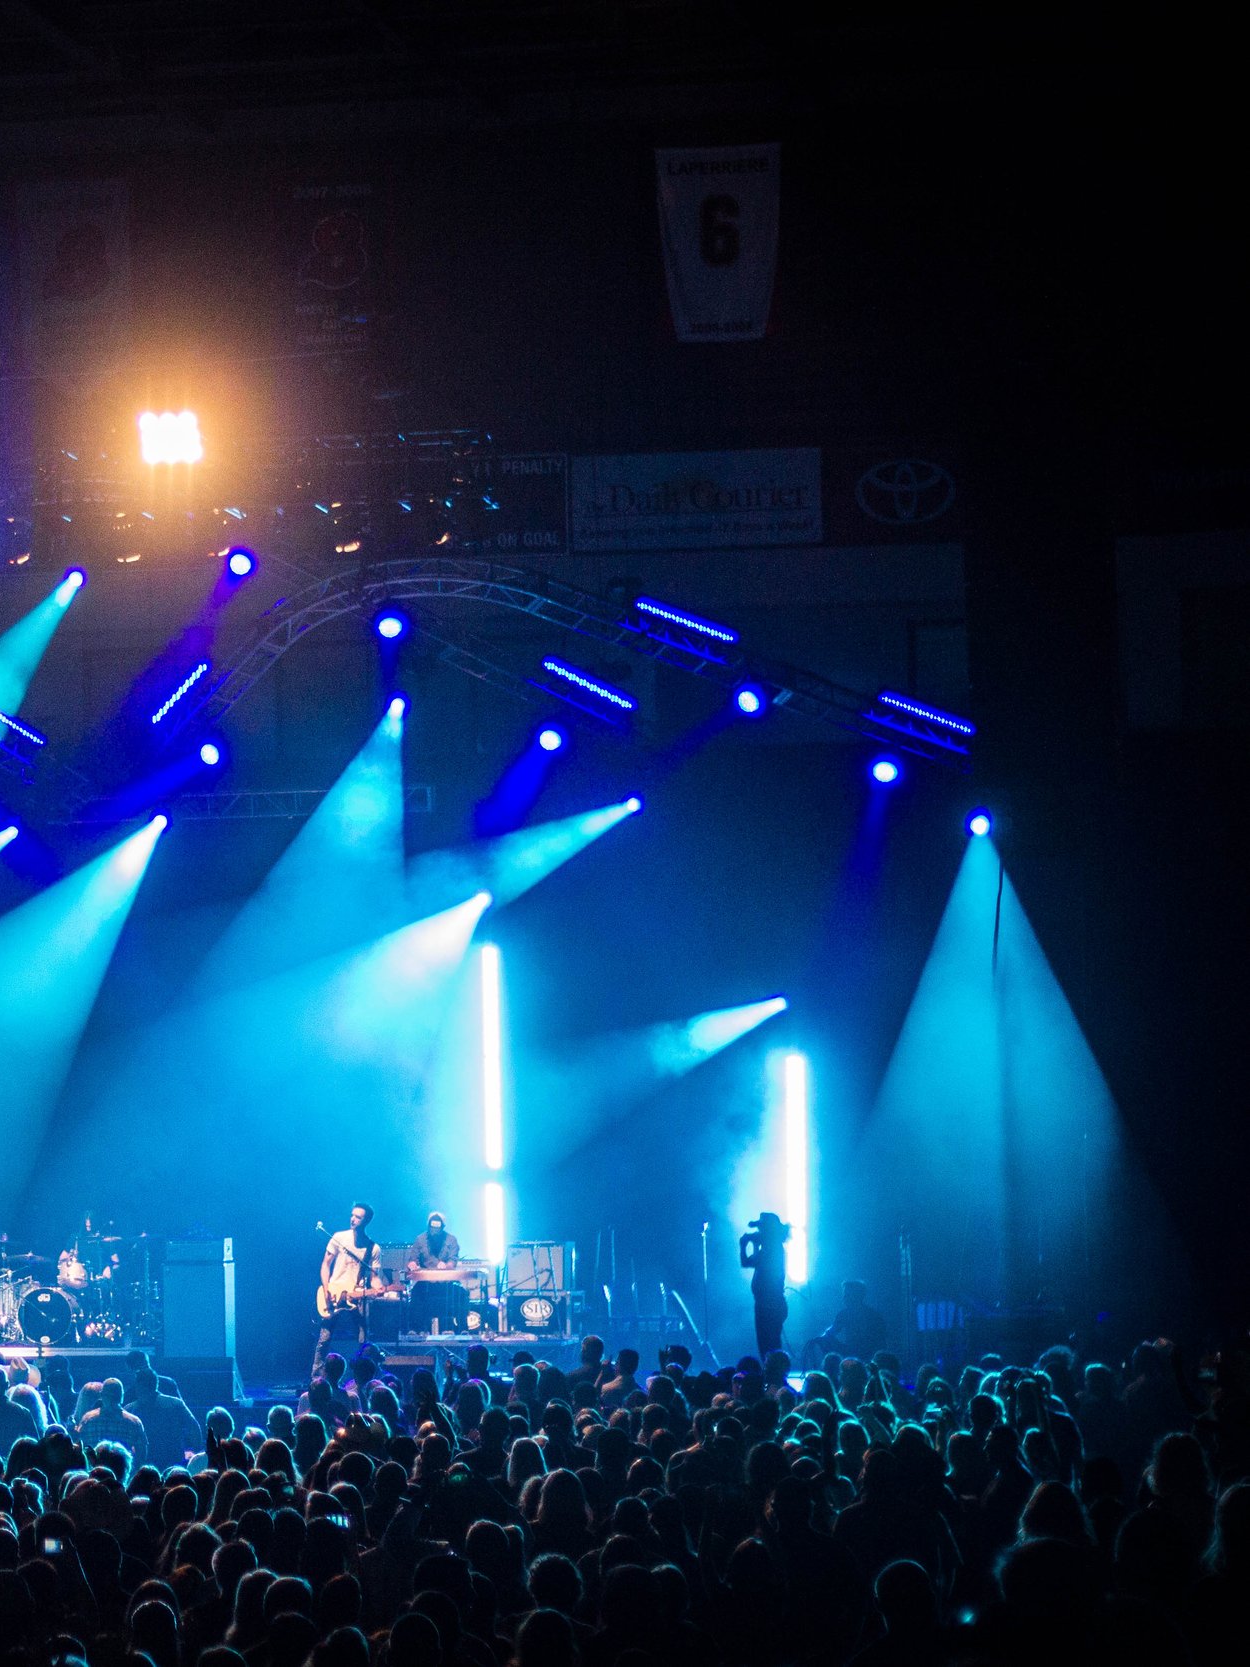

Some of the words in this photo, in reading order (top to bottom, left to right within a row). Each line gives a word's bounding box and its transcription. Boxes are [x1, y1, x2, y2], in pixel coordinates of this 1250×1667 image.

[667, 158, 768, 176] LAPERRIERE
[701, 195, 739, 267] 6
[502, 459, 563, 475] PENALTY
[609, 481, 680, 515] Daily
[689, 479, 809, 511] Courier
[497, 531, 518, 548] ON
[523, 530, 560, 547] GOAL
[526, 1303, 549, 1314] SIR
